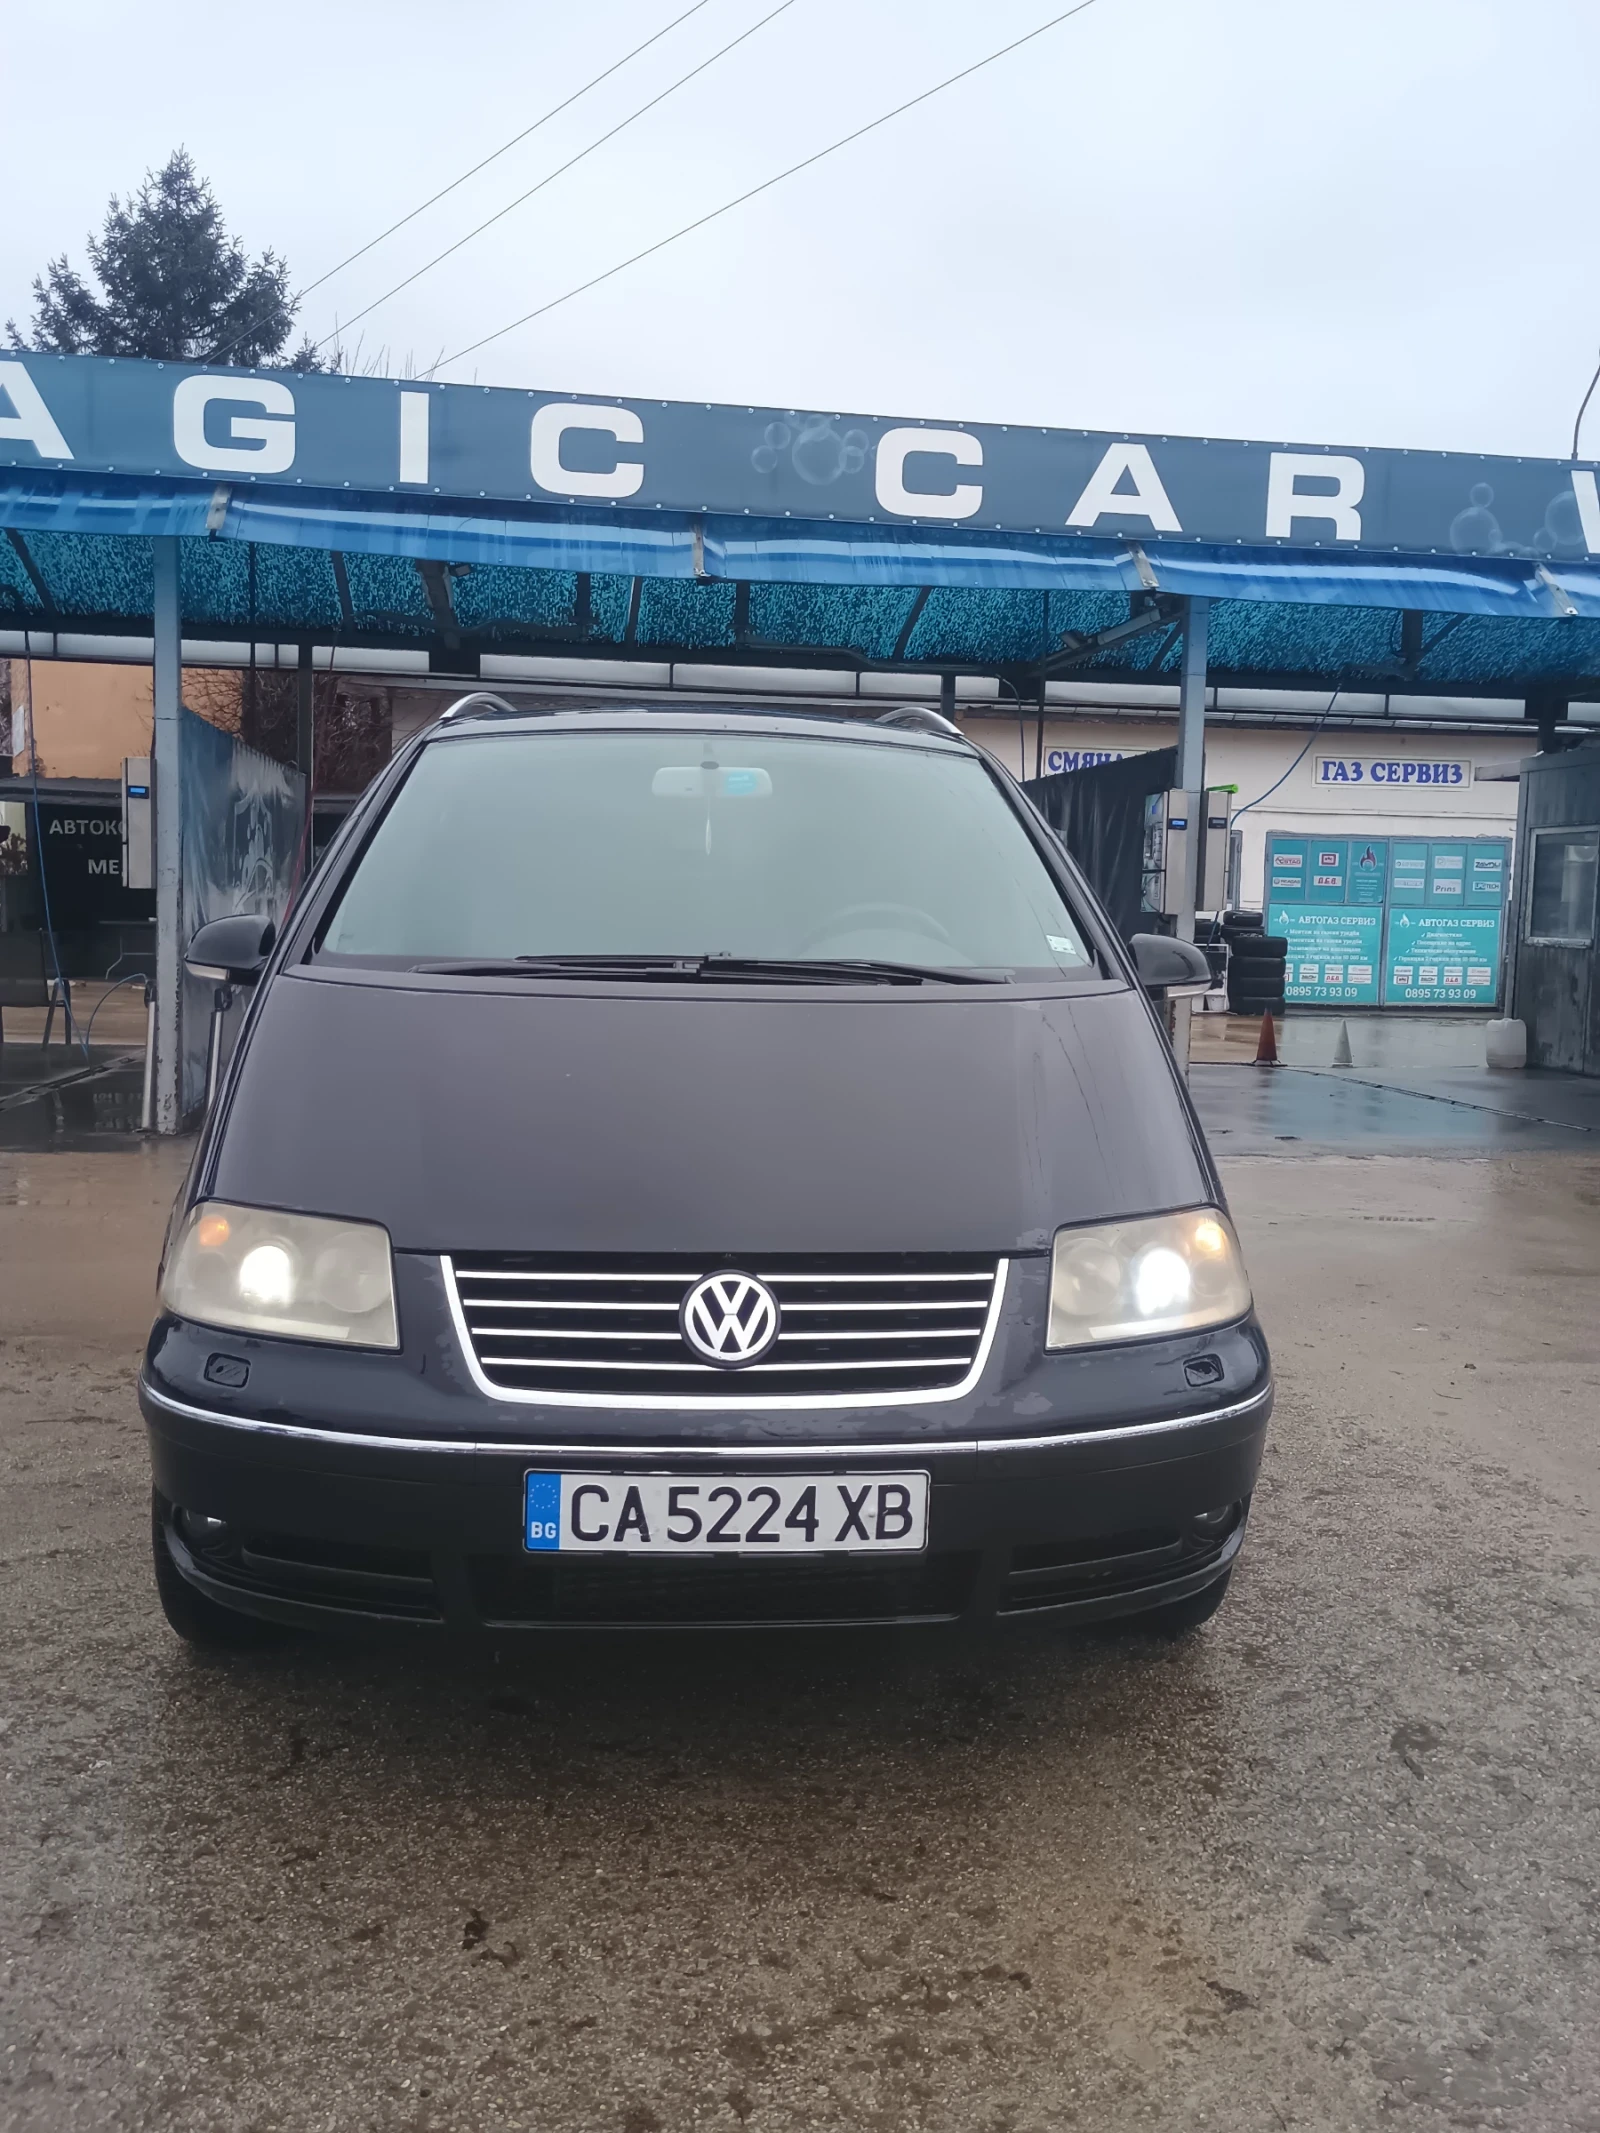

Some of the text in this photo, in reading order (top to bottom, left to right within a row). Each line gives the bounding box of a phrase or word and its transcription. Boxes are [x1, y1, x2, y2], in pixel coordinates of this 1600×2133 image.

[875, 427, 1366, 541] CAR
[1048, 751, 1124, 772] СМЯН
[1321, 760, 1463, 784] ГАЗ СЕРВИЗ
[88, 859, 123, 875] МЕ
[1298, 915, 1376, 926] АВТОГАЗ СЕРВИЗ
[1418, 918, 1495, 928] АВТОГАЗ СЕРВИЗ
[1286, 986, 1358, 998] 0895 73 93 09
[1405, 988, 1477, 999] 0895 73 93 09
[571, 1484, 913, 1543] CA 5224 XB
[530, 1521, 557, 1539] BG
